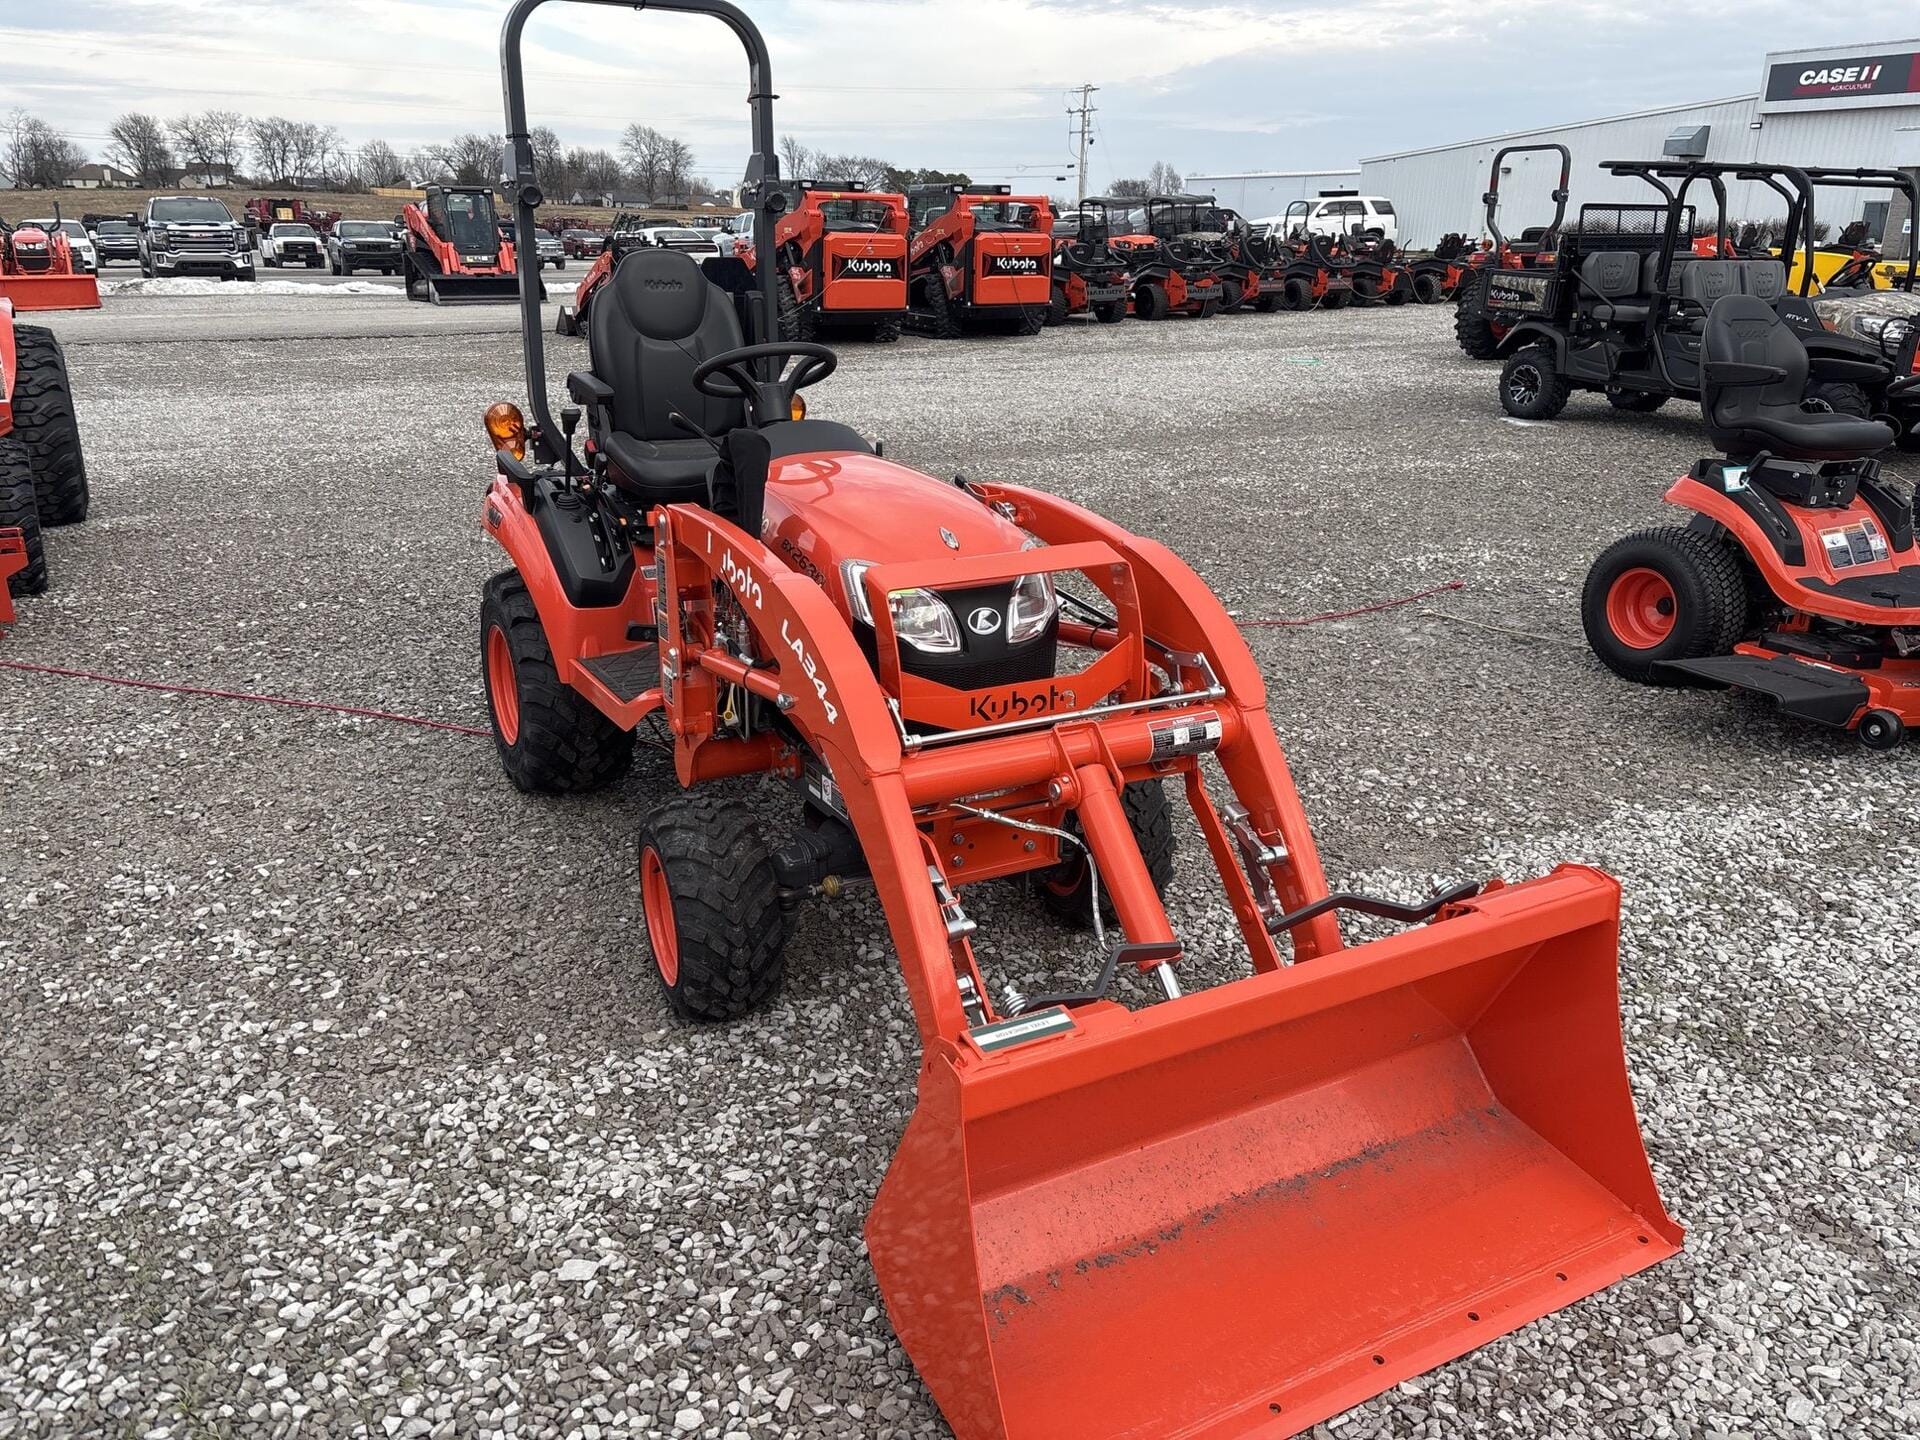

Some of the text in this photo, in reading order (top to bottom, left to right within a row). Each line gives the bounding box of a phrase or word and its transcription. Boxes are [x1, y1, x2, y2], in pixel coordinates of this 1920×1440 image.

[1799, 67, 1860, 86] CASE
[1830, 83, 1872, 92] AGRICULTURE
[847, 258, 892, 273] Kubota
[996, 257, 1037, 270] Kubota
[1490, 289, 1520, 301] Kubota
[781, 618, 838, 725] LA344
[970, 684, 1077, 721] Kubota
